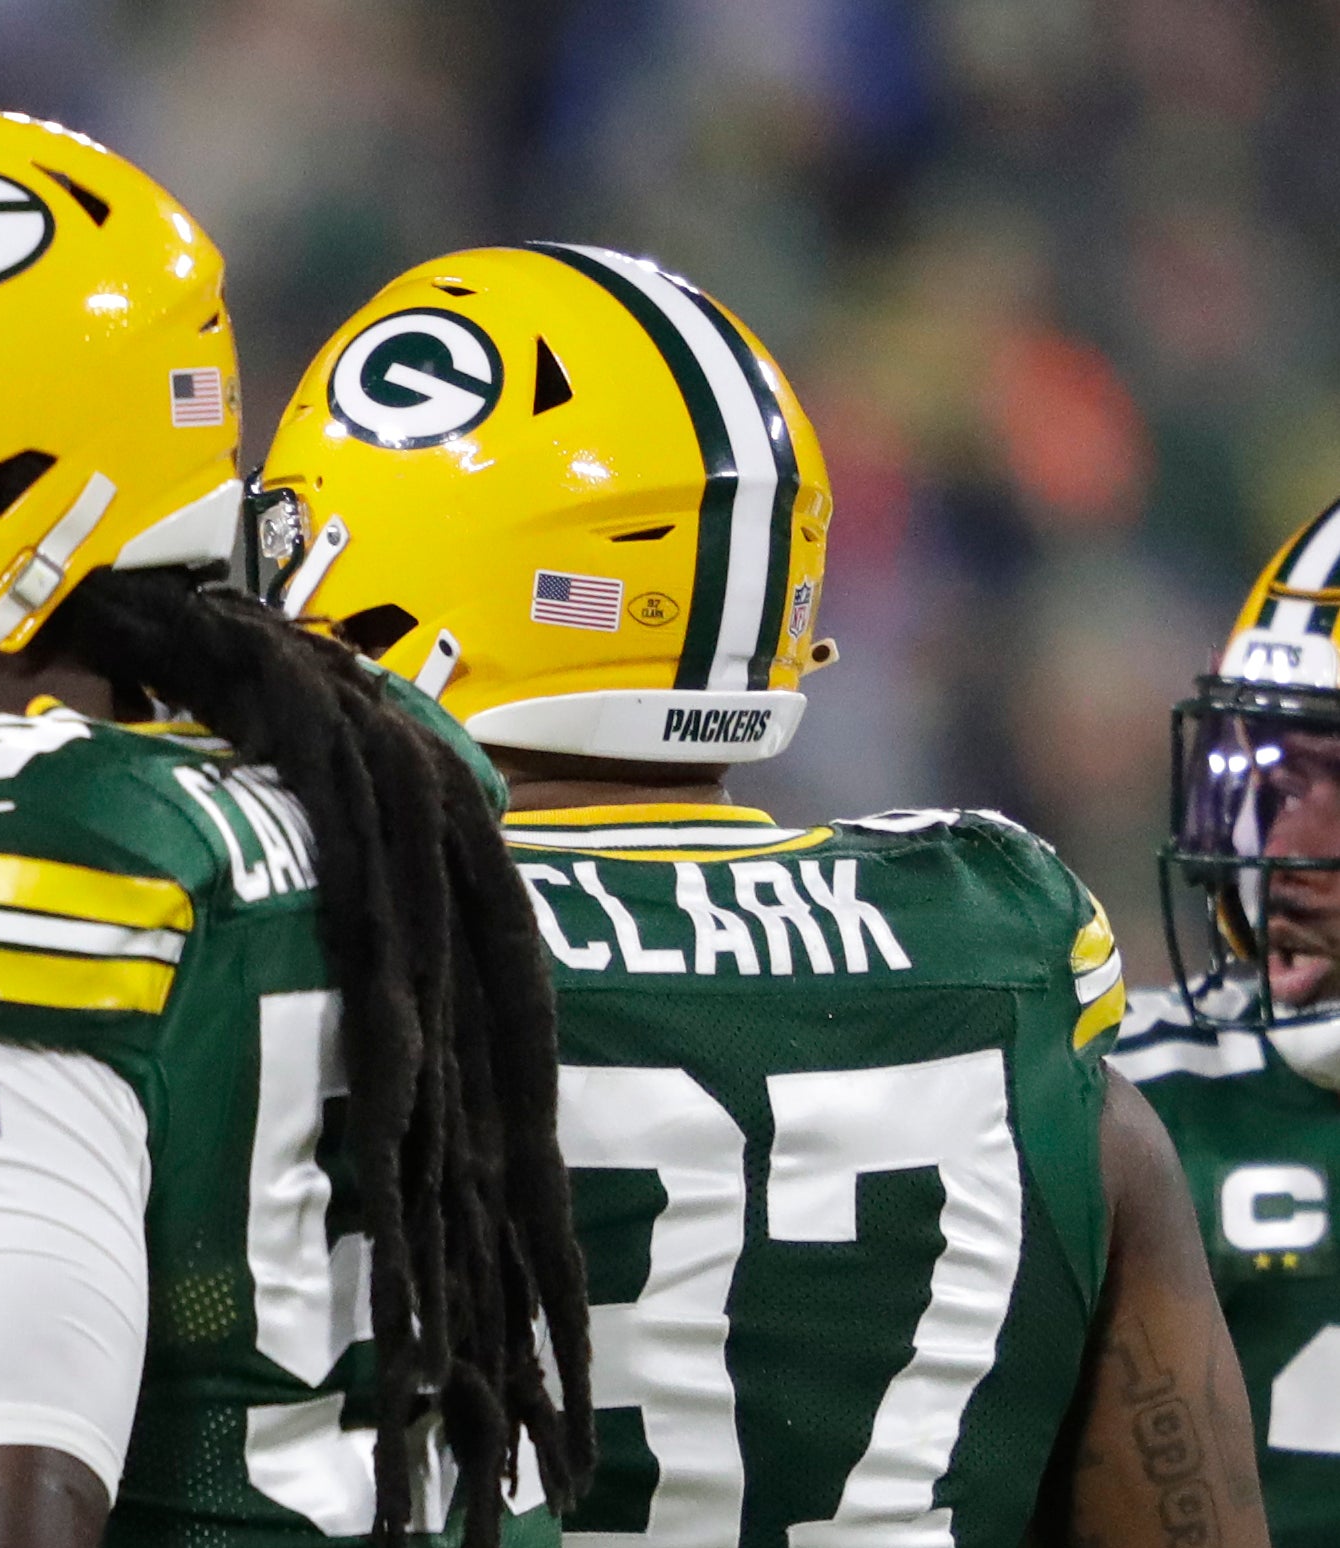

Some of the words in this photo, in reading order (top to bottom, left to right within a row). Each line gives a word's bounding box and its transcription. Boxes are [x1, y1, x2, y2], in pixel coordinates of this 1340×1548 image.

[662, 708, 772, 742] PACKERS
[514, 859, 914, 976] CLARK
[1221, 1164, 1328, 1251] C
